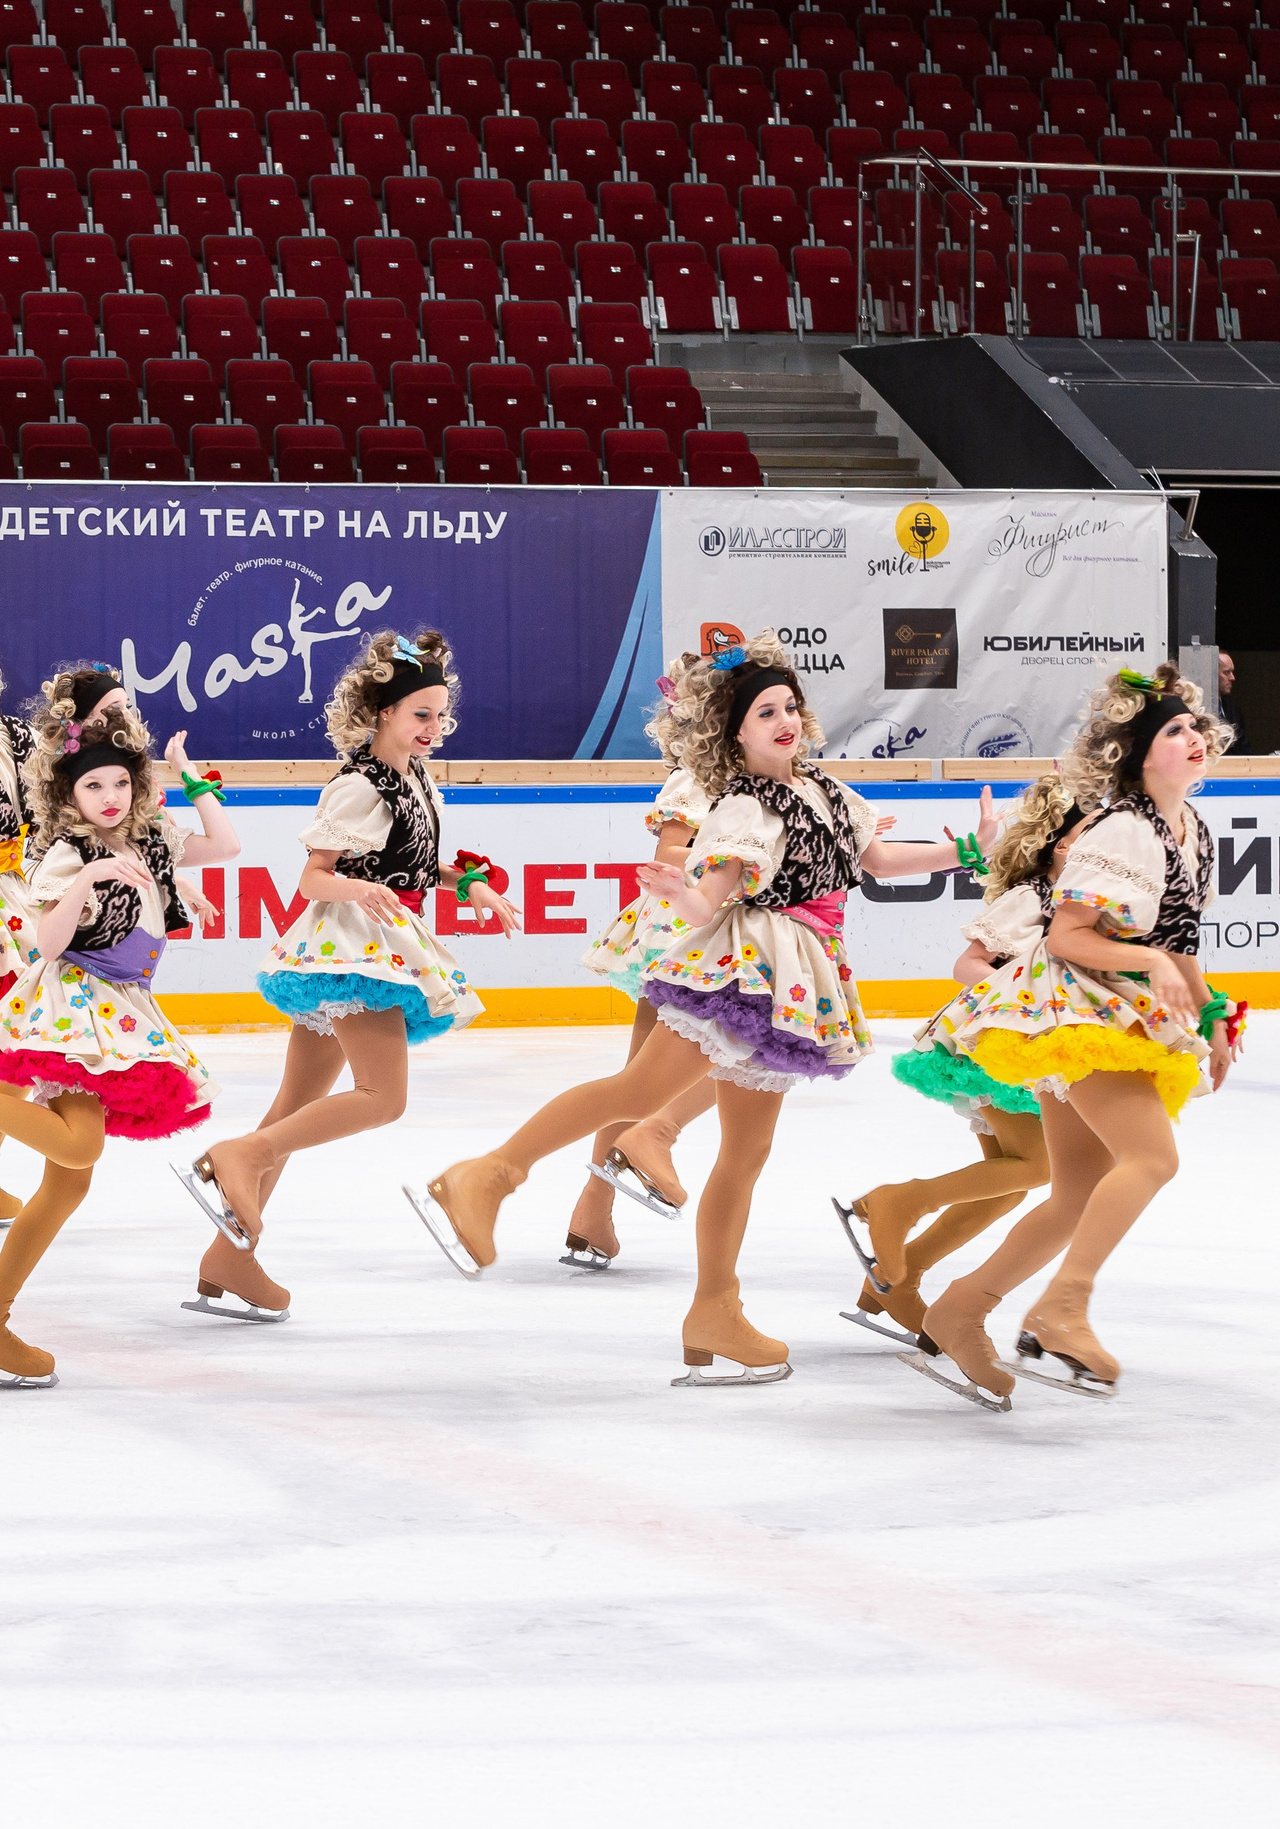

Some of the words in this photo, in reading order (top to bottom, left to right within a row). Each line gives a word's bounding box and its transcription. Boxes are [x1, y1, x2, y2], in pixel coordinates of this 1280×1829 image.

[200, 508, 325, 537] ТЕАТР
[338, 510, 392, 538] НА
[403, 510, 508, 544] ЛЬДУ
[728, 526, 847, 549] ИЛАССТРОЙ
[984, 514, 1125, 578] Фигурист
[868, 551, 918, 577] smile
[187, 595, 209, 627] балет.
[205, 570, 233, 593] театр.
[234, 557, 283, 574] фигурное
[284, 559, 324, 586] катание.
[121, 580, 393, 713] Maska
[777, 627, 828, 648] ОДО
[983, 631, 1145, 652] ЮБИЛЕЙНЫЙ
[786, 653, 845, 674] ЦЦА
[891, 648, 916, 656] RIVER
[917, 648, 950, 656] PALACE
[906, 657, 937, 665] HOTEL
[1021, 656, 1065, 666] ДВОРЕЦ
[1066, 657, 1108, 666] СПОРА
[251, 729, 296, 740] школа
[308, 711, 328, 730] сту
